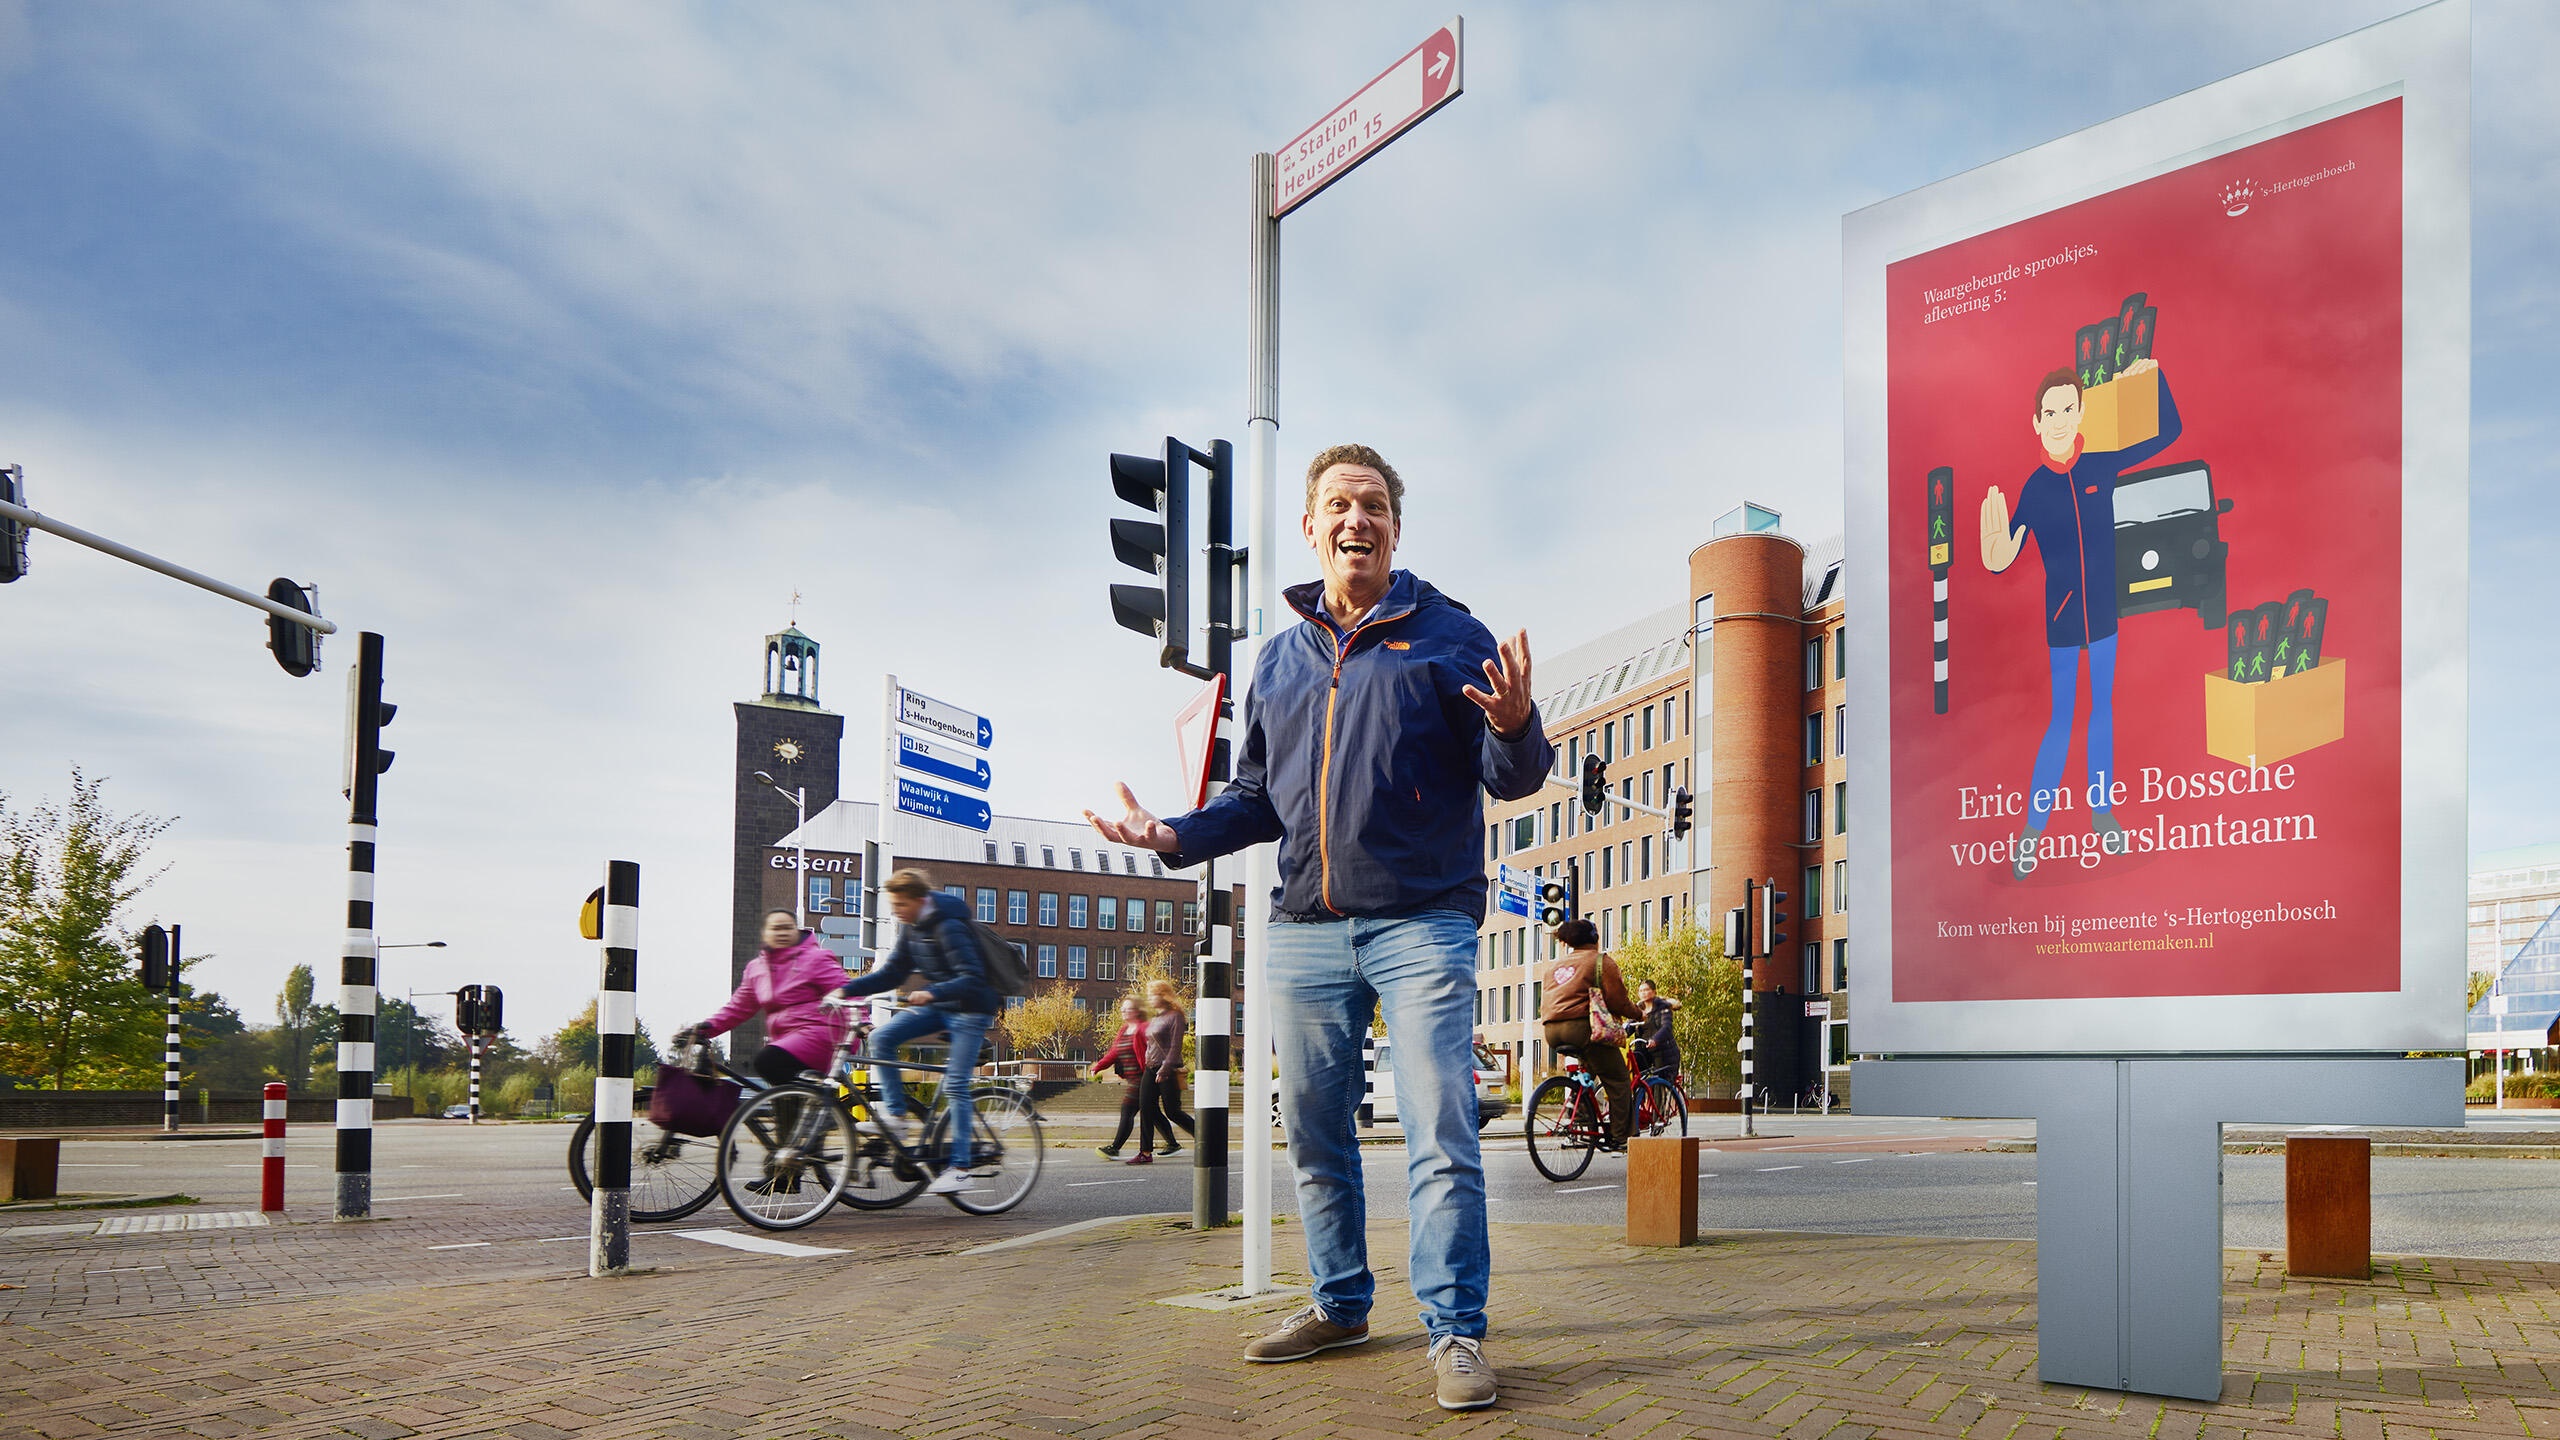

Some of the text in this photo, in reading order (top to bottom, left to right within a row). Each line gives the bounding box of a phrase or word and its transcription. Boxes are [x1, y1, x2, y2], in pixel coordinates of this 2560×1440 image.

[1300, 108, 1358, 162] Station
[1284, 113, 1382, 197] Heusden 15
[2260, 159, 2356, 197] 's-Hertogenbosch
[1923, 243, 2098, 304] Waargebeurde sprookjes,
[1923, 288, 2007, 324] aflevering 5:
[906, 693, 926, 709] Ring
[904, 708, 975, 740] 's-Hertogenbosch
[914, 741, 929, 754] JBZ
[901, 782, 941, 802] Waalwijk
[1958, 754, 2296, 820] Eric en de Bossche
[901, 796, 935, 814] Vlijmen
[1950, 812, 2318, 873] voetgangerslantaarn
[770, 854, 853, 874] essent
[1937, 921, 1973, 938] Kom
[1978, 917, 2039, 936] werken
[2044, 915, 2066, 937] bij
[2071, 911, 2158, 937] gemeente
[2036, 932, 2214, 955] werkomwaartemaken.nl
